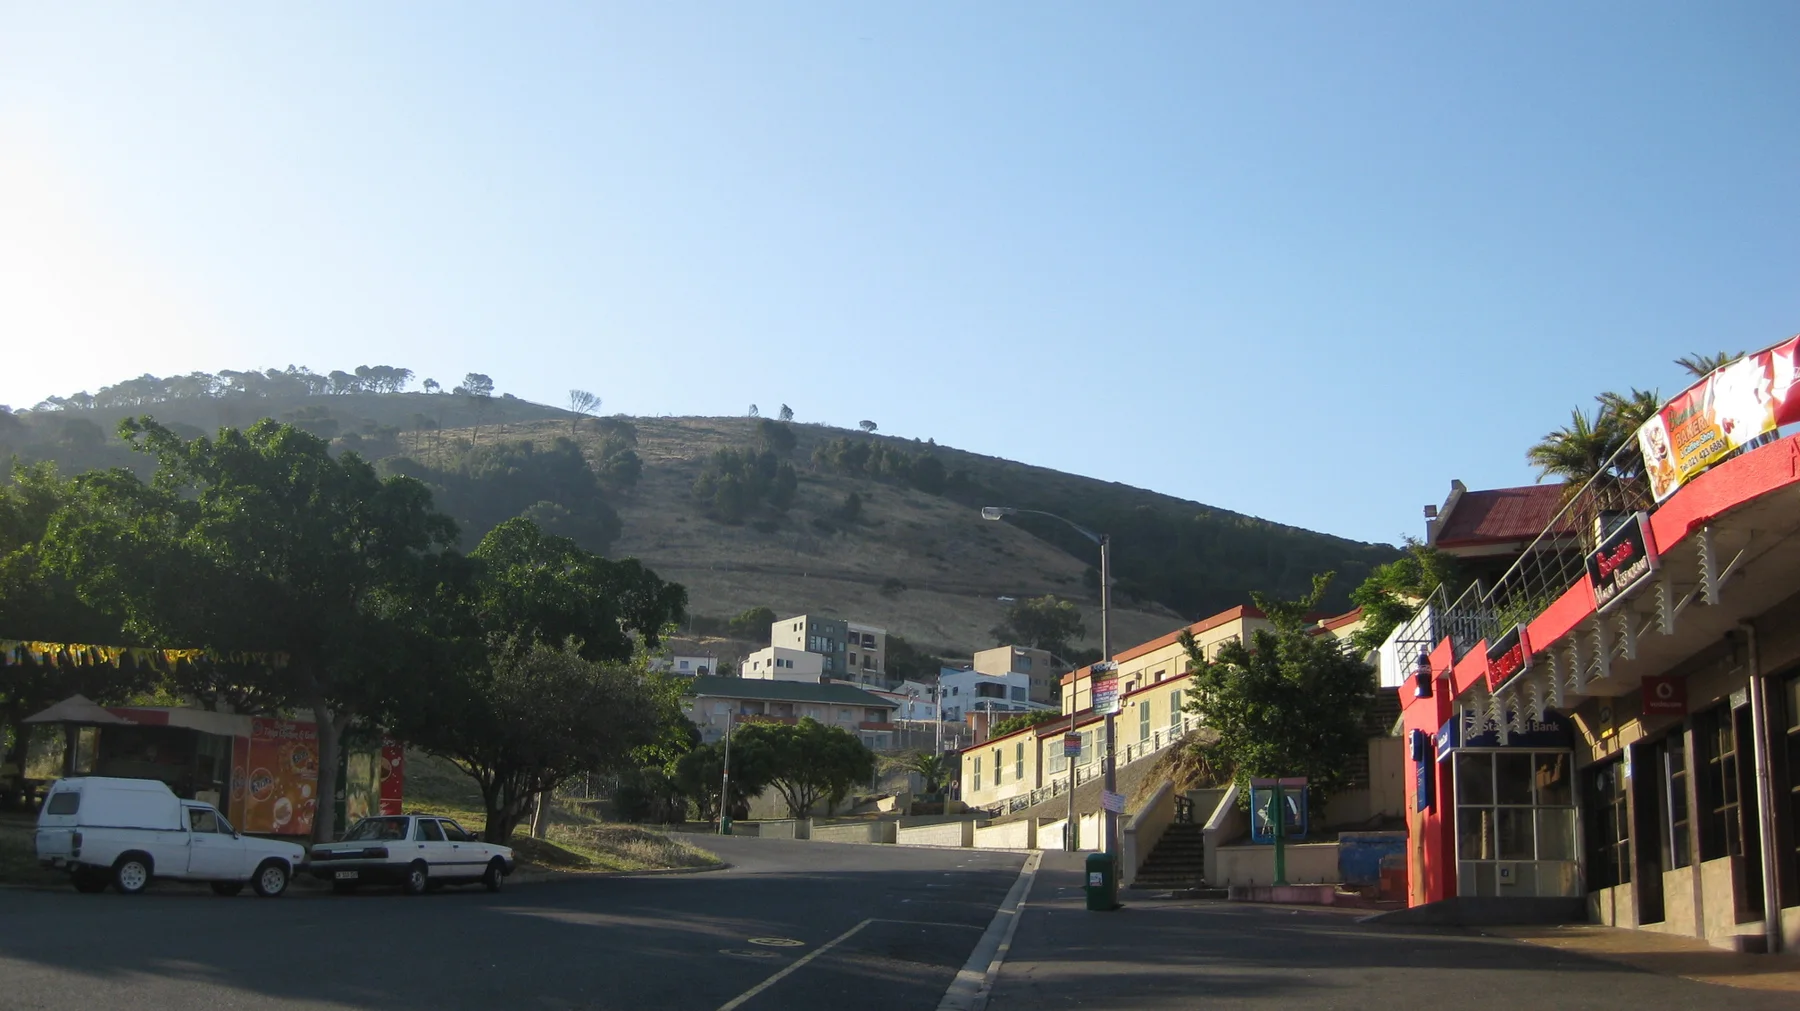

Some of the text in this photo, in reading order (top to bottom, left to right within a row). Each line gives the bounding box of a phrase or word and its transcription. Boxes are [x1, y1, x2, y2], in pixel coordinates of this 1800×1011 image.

[1675, 411, 1715, 449] BAKERY
[1700, 430, 1715, 444] Shop
[1688, 455, 1699, 467] 021
[1699, 447, 1710, 459] 423
[1532, 721, 1560, 732] Bank
